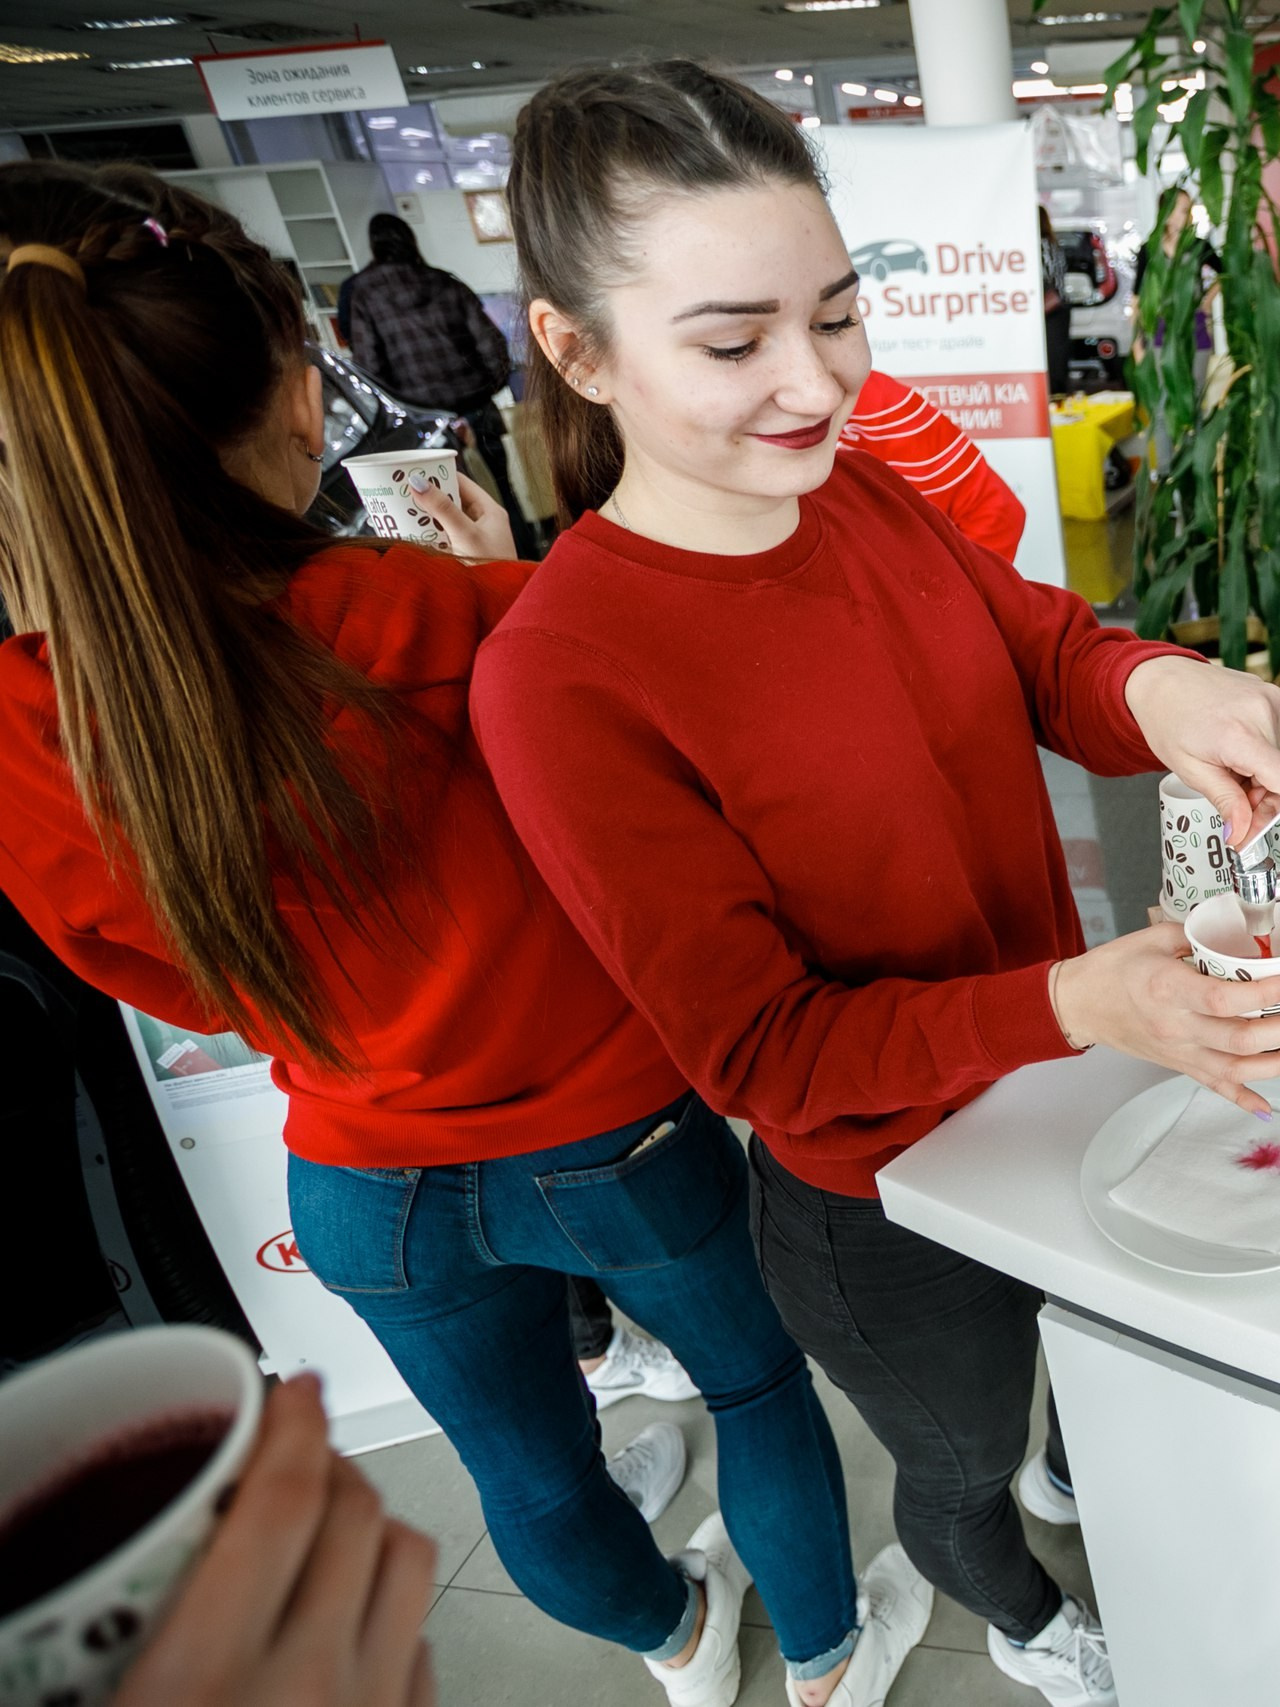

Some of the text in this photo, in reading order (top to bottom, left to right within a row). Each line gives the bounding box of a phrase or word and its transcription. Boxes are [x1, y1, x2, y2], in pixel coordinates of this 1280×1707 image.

[247, 64, 351, 85] Зона ожидания
[247, 86, 367, 108] клиентов сервиса
[936, 242, 1026, 275] Drive
[883, 284, 1029, 324] Surprise
[994, 382, 1030, 405] KIA
